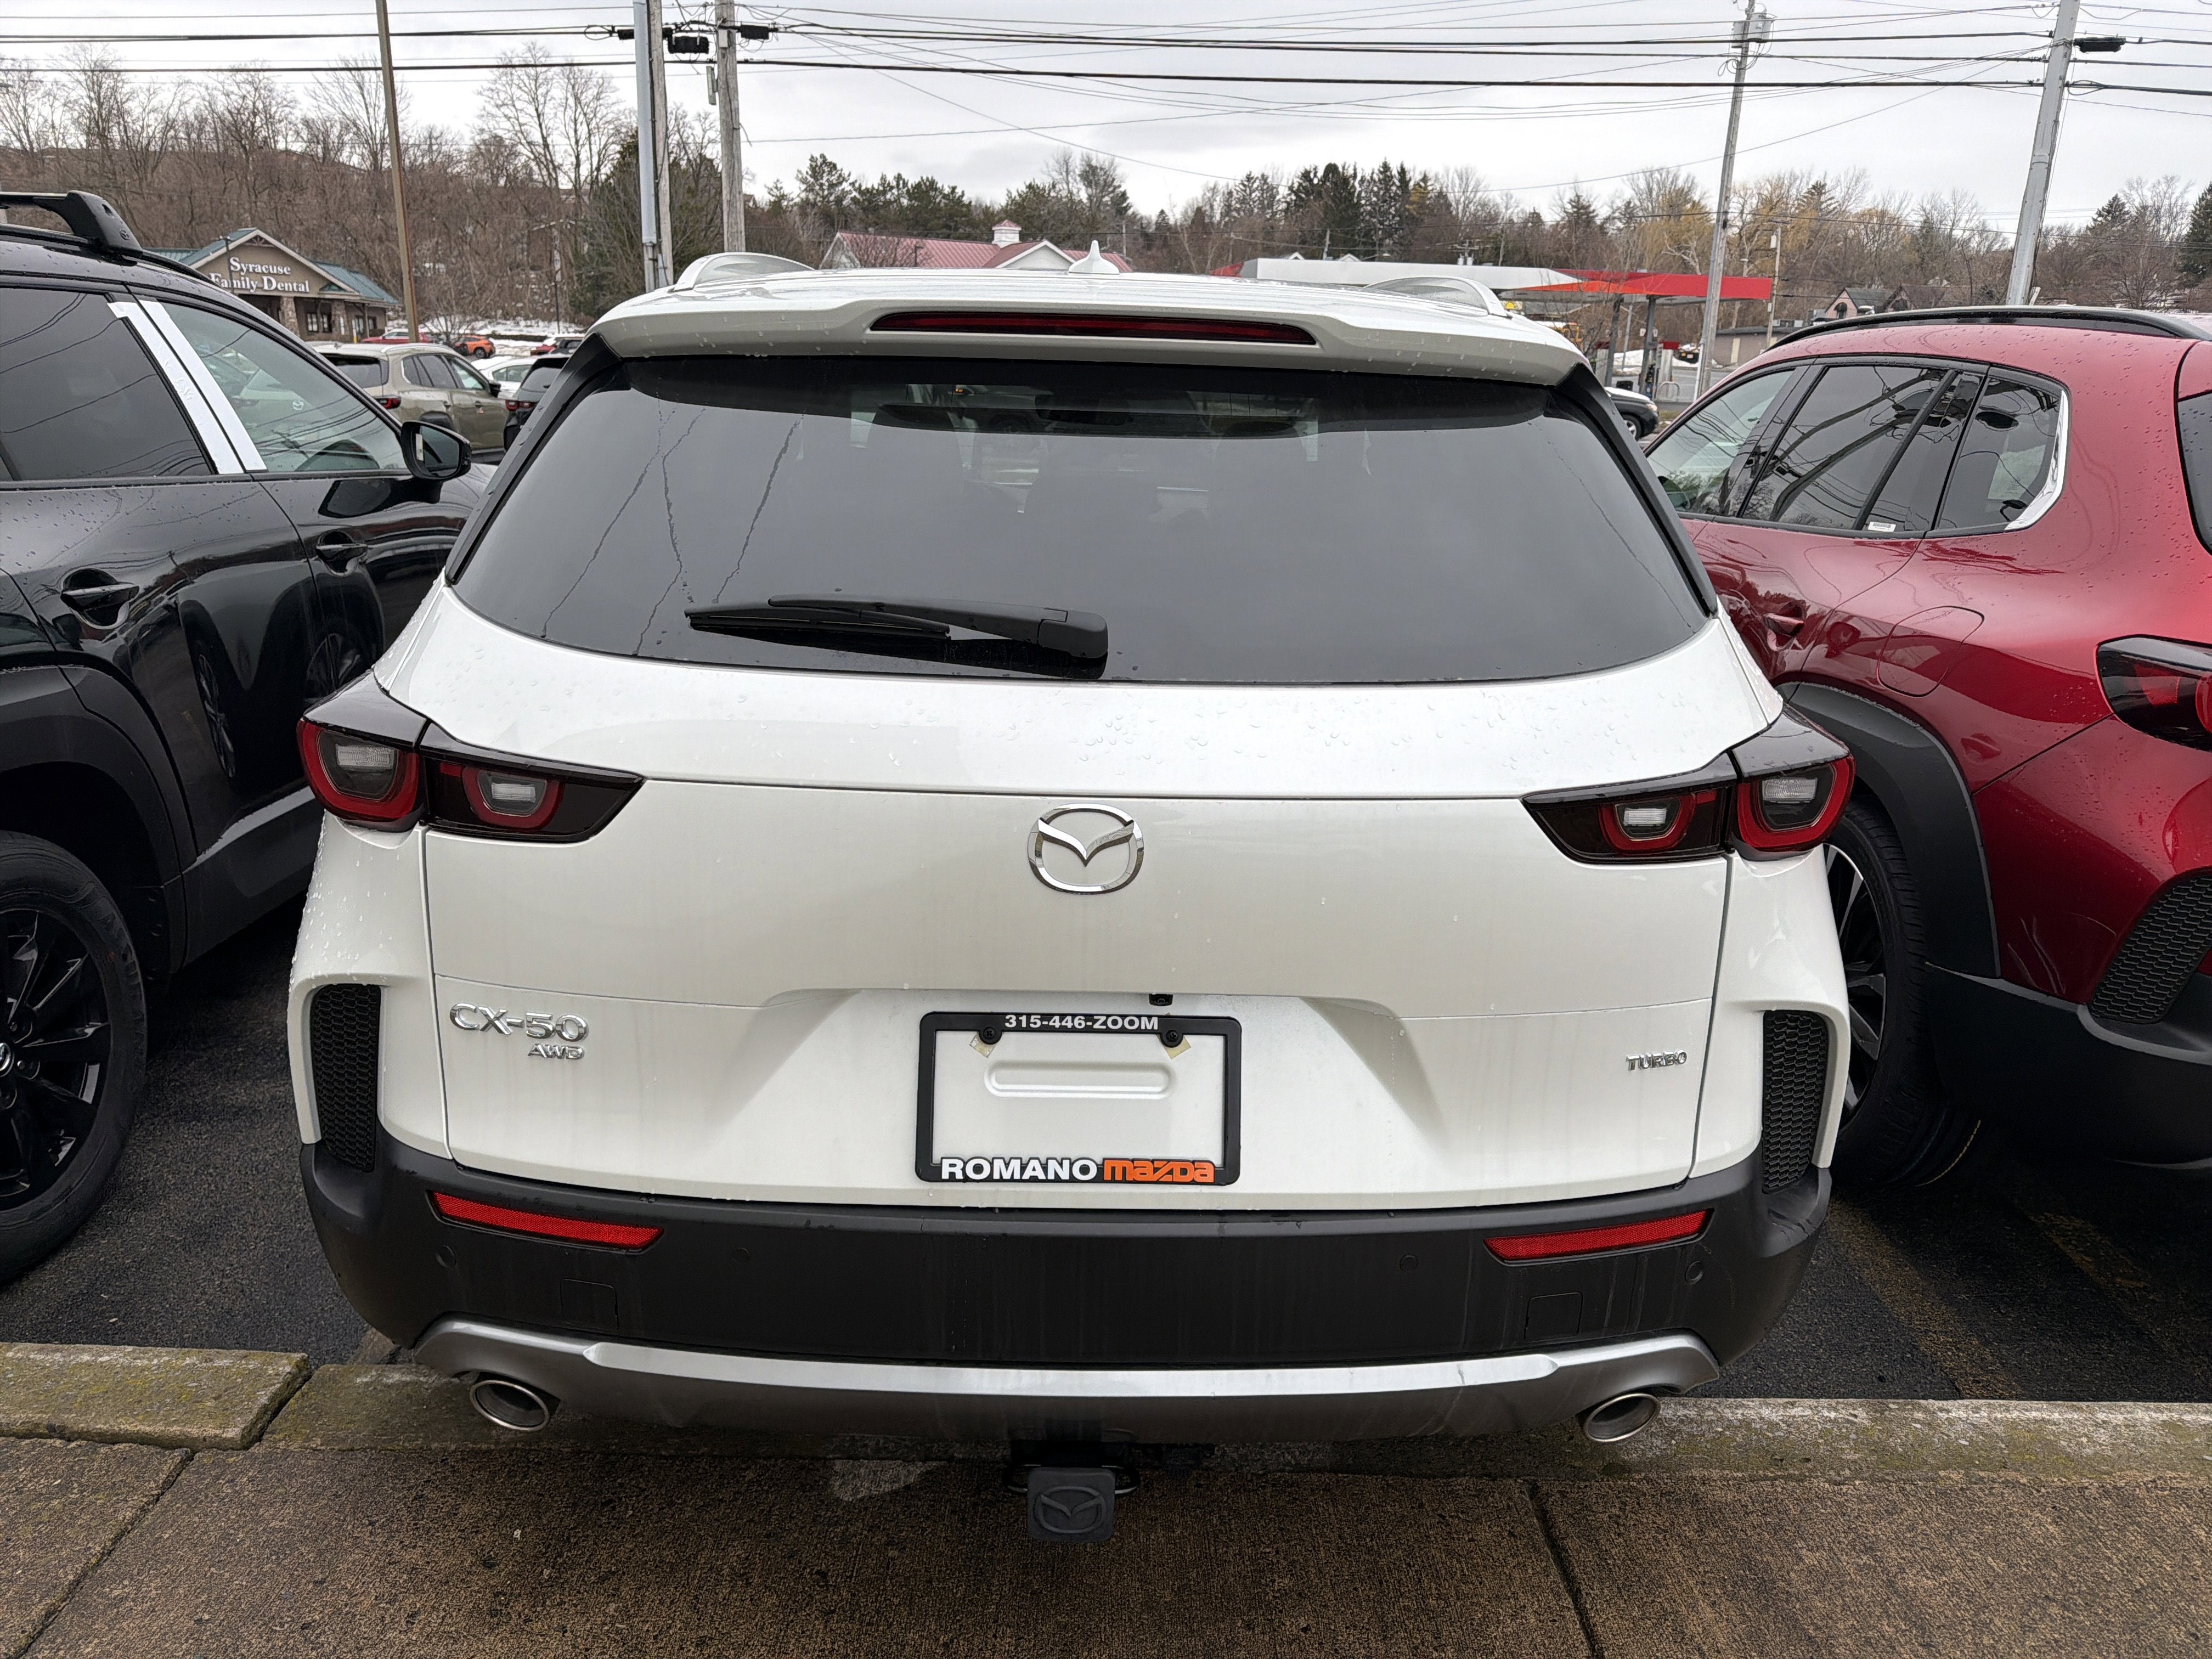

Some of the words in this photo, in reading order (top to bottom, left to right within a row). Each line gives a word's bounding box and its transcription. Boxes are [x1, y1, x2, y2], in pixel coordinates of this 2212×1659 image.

[229, 257, 291, 275] Syracuse
[262, 275, 310, 292] Dental
[449, 1002, 589, 1042] CX-50
[1005, 1014, 1159, 1030] 315-446-ZOOM
[527, 1043, 585, 1060] AWD
[1626, 1049, 1688, 1071] TURBO
[941, 1159, 1097, 1180] ROMANO
